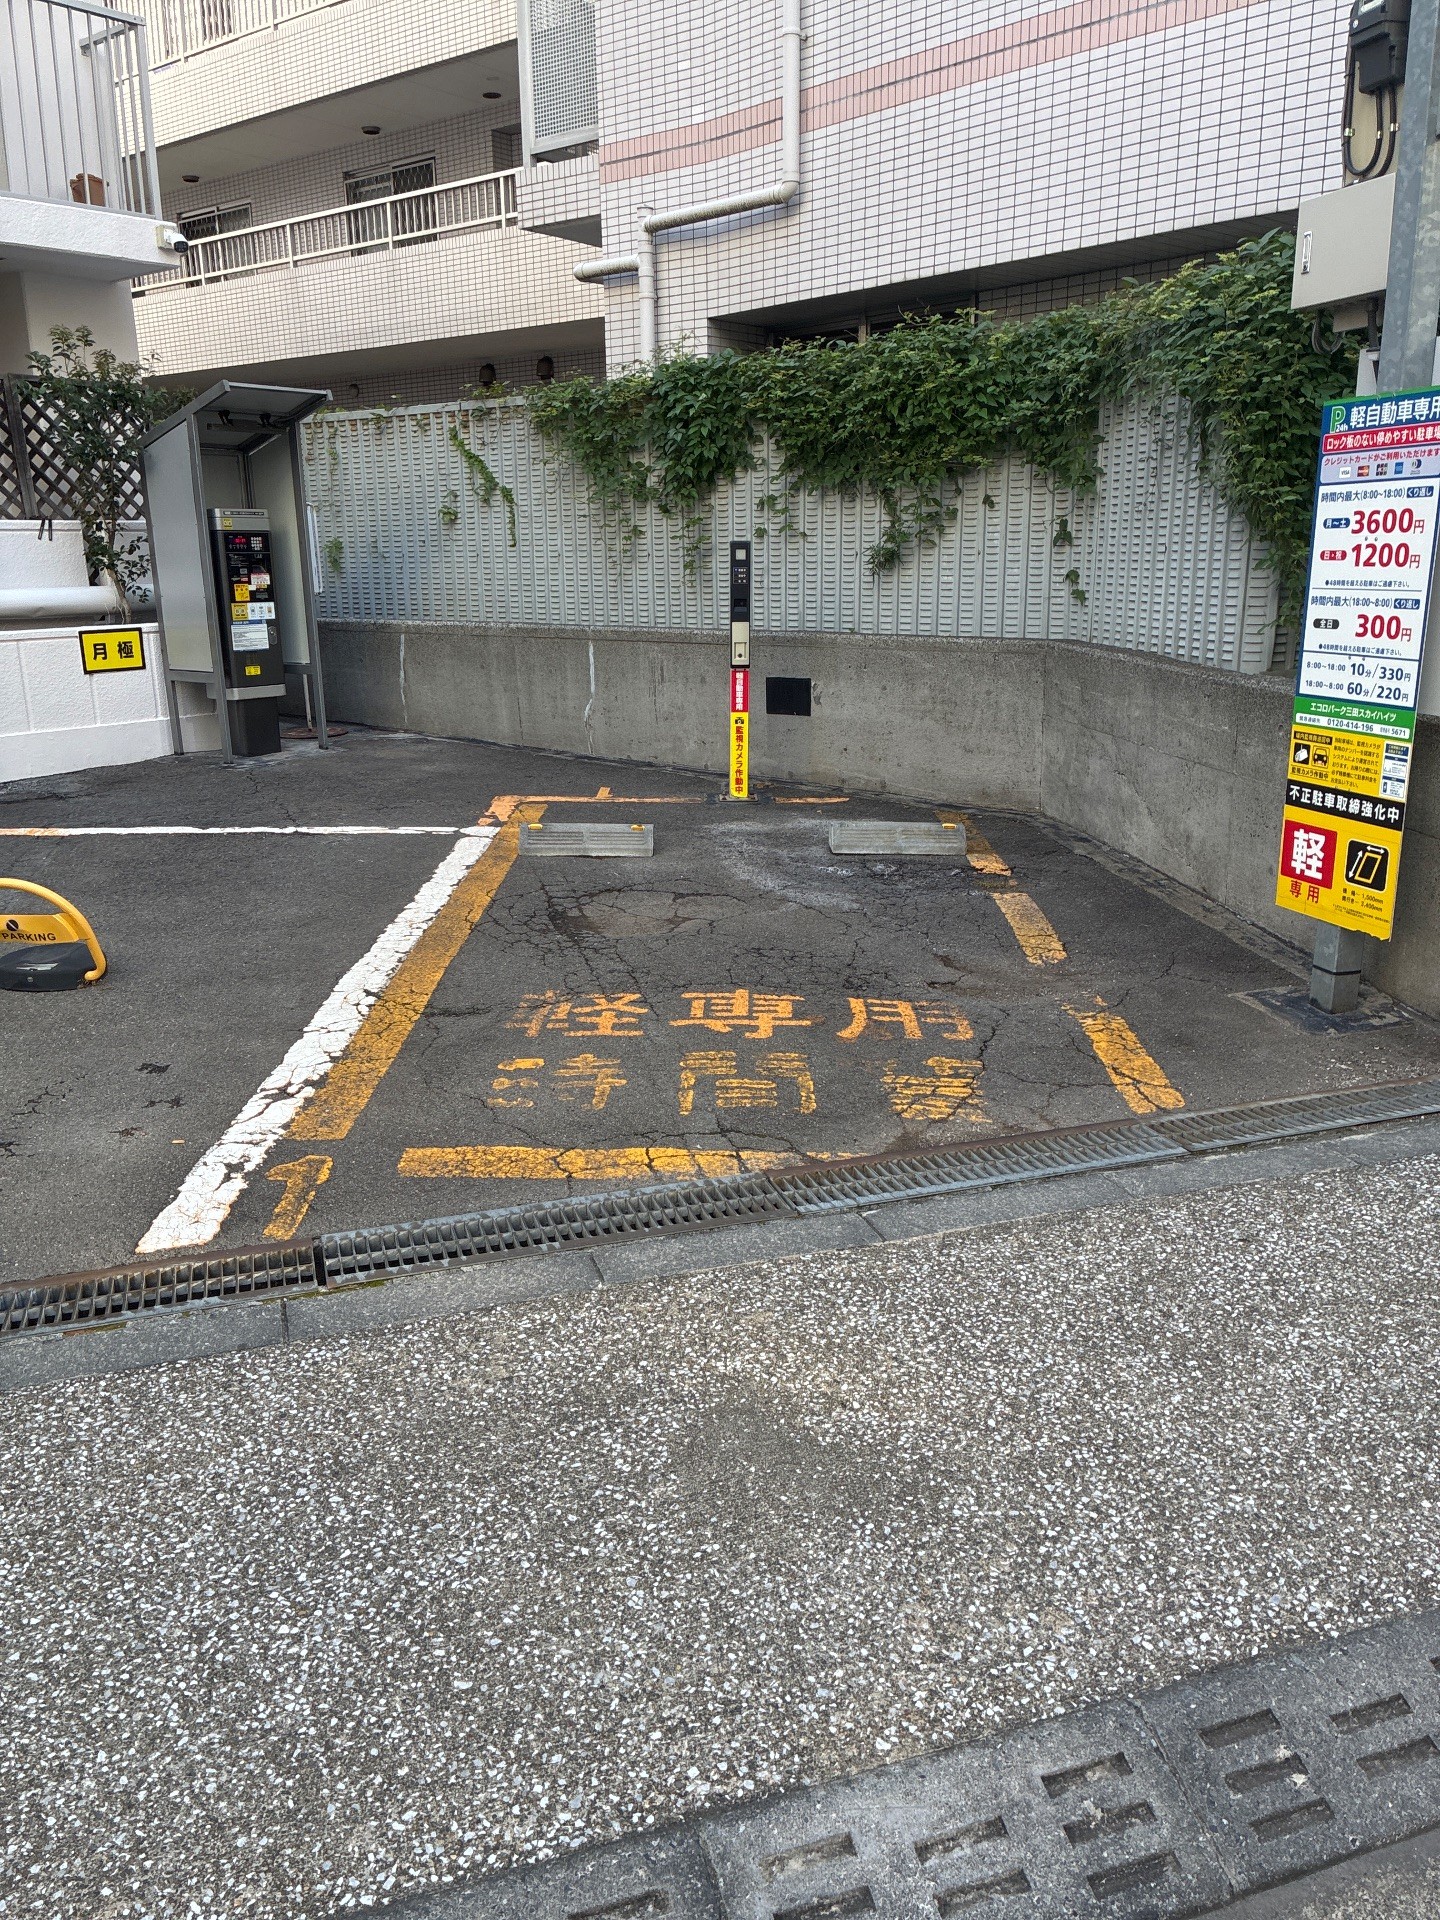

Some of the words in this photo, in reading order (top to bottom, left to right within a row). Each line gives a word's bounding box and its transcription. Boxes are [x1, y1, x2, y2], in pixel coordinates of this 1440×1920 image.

[1350, 395, 1440, 429] 軽自動車専用
[1407, 487, 1433, 497] くり返し
[1394, 599, 1419, 609] くり返し
[1319, 619, 1333, 628] 全日
[93, 641, 134, 661] 月極
[1310, 702, 1397, 722] エコロパーク三田スカイハイツ
[1327, 718, 1374, 732] 0120-414-196
[1391, 728, 1406, 737] 5671
[735, 725, 744, 794] 監視カメラ作動中
[1289, 784, 1400, 824] 不正駐車取締強化中
[1290, 828, 1325, 880] 軽
[1290, 879, 1320, 904] 専用
[1, 932, 57, 942] PARKING
[505, 988, 975, 1042] 軽専用
[263, 1154, 334, 1241] 1
